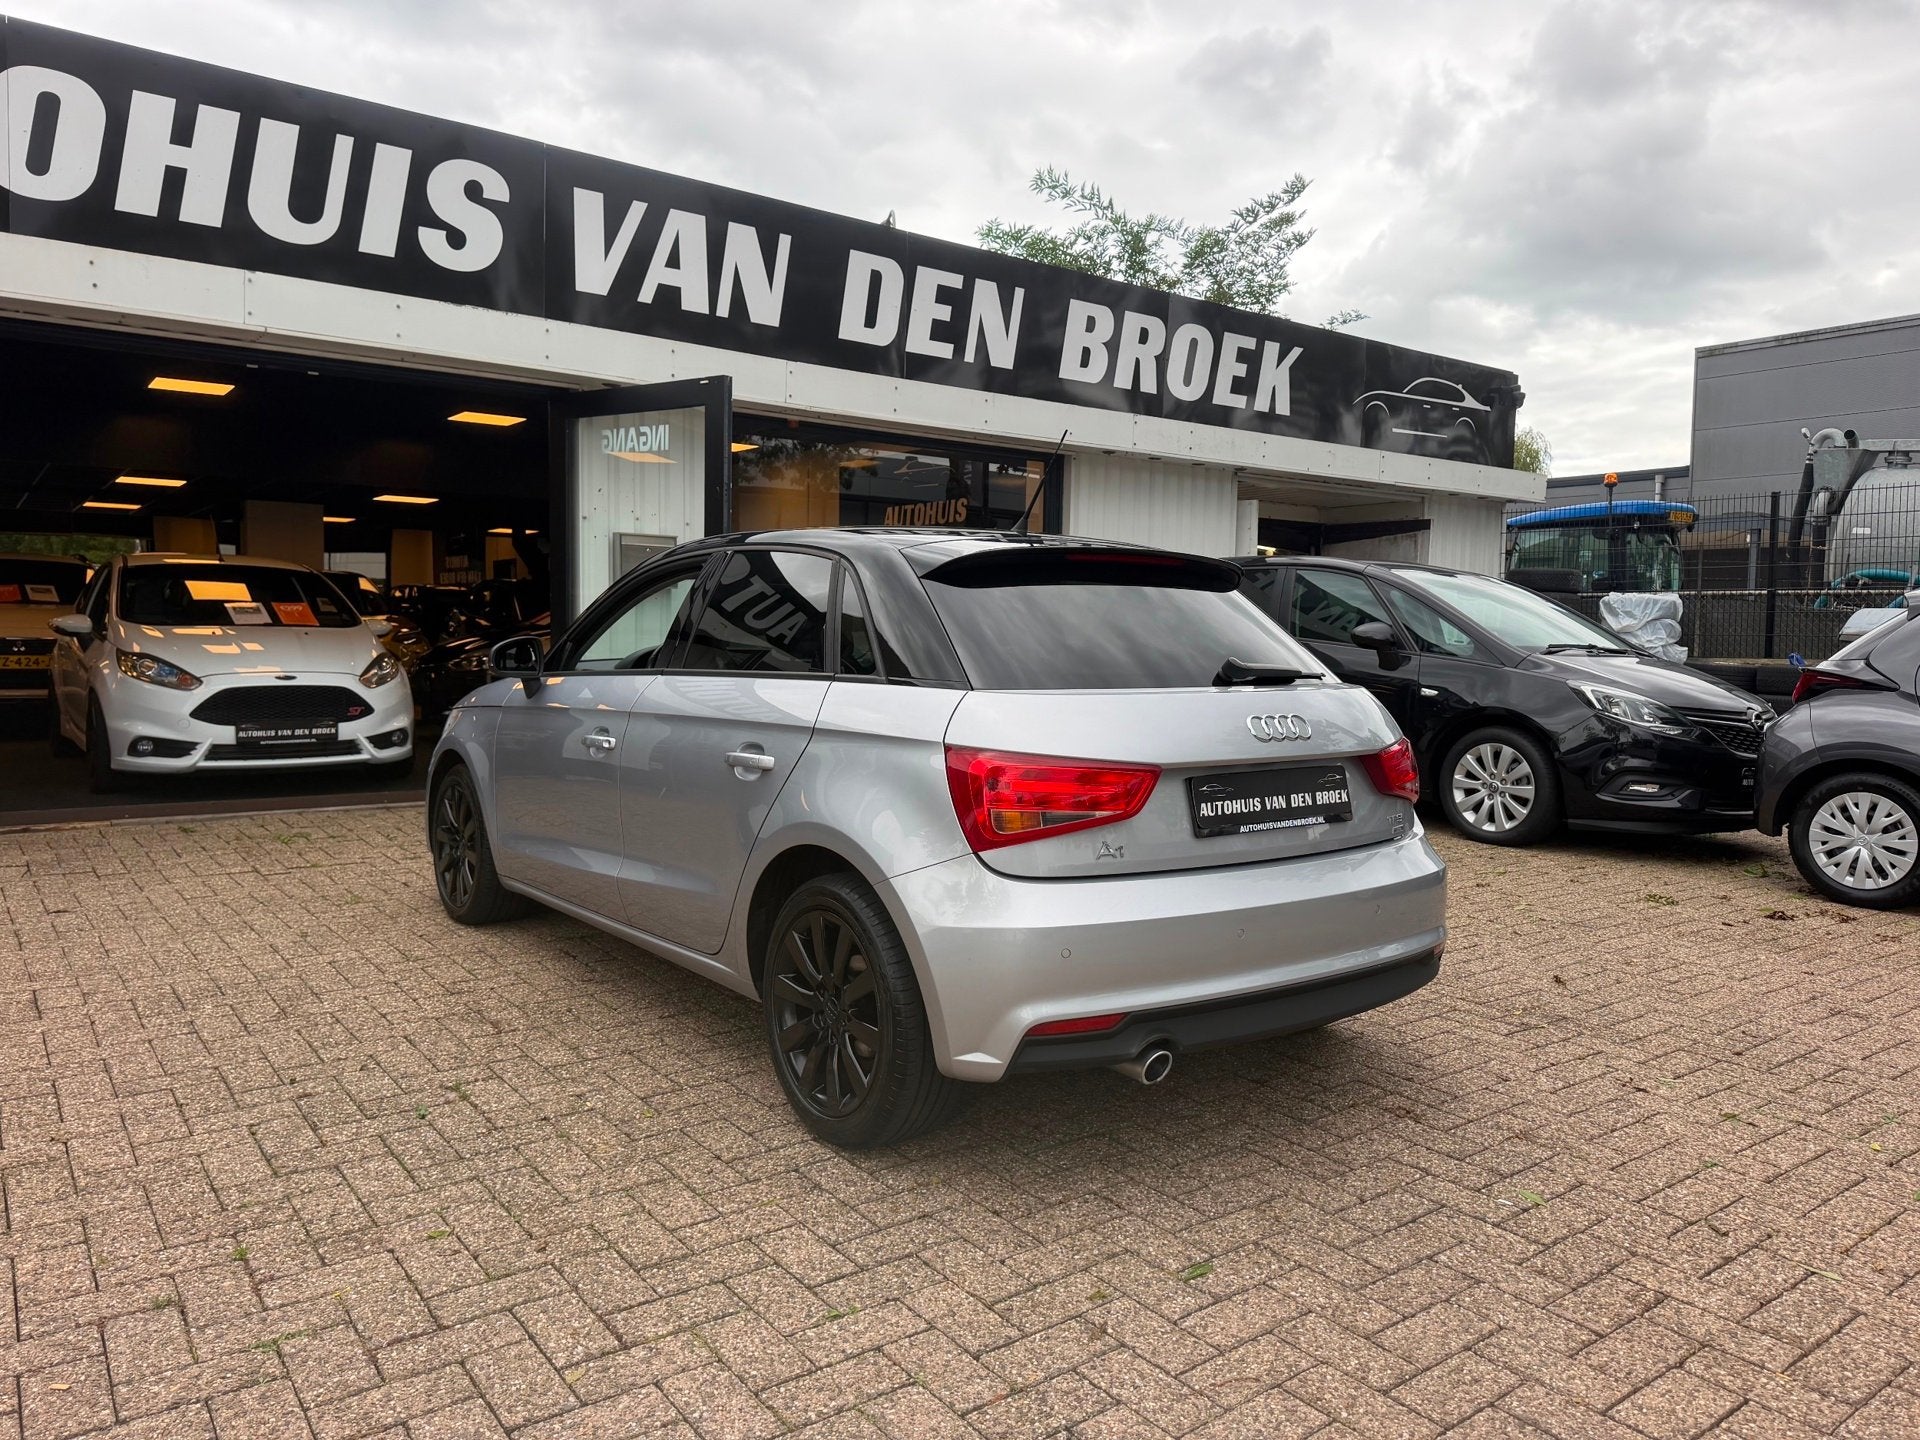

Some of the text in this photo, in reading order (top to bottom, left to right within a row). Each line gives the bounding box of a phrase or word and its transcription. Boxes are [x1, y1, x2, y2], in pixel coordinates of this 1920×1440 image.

[0, 65, 1304, 416] OHUIS VAN DEN BROEK
[884, 498, 968, 526] AUTOHUIS
[238, 730, 276, 738] AUTOHUIS
[312, 727, 337, 735] BROEK
[1200, 789, 1349, 817] AUTOHUIS VAN DEN BROEK
[1239, 816, 1326, 833] AUTOHUISVANDENBROEK.NL
[1096, 841, 1124, 860] A1
